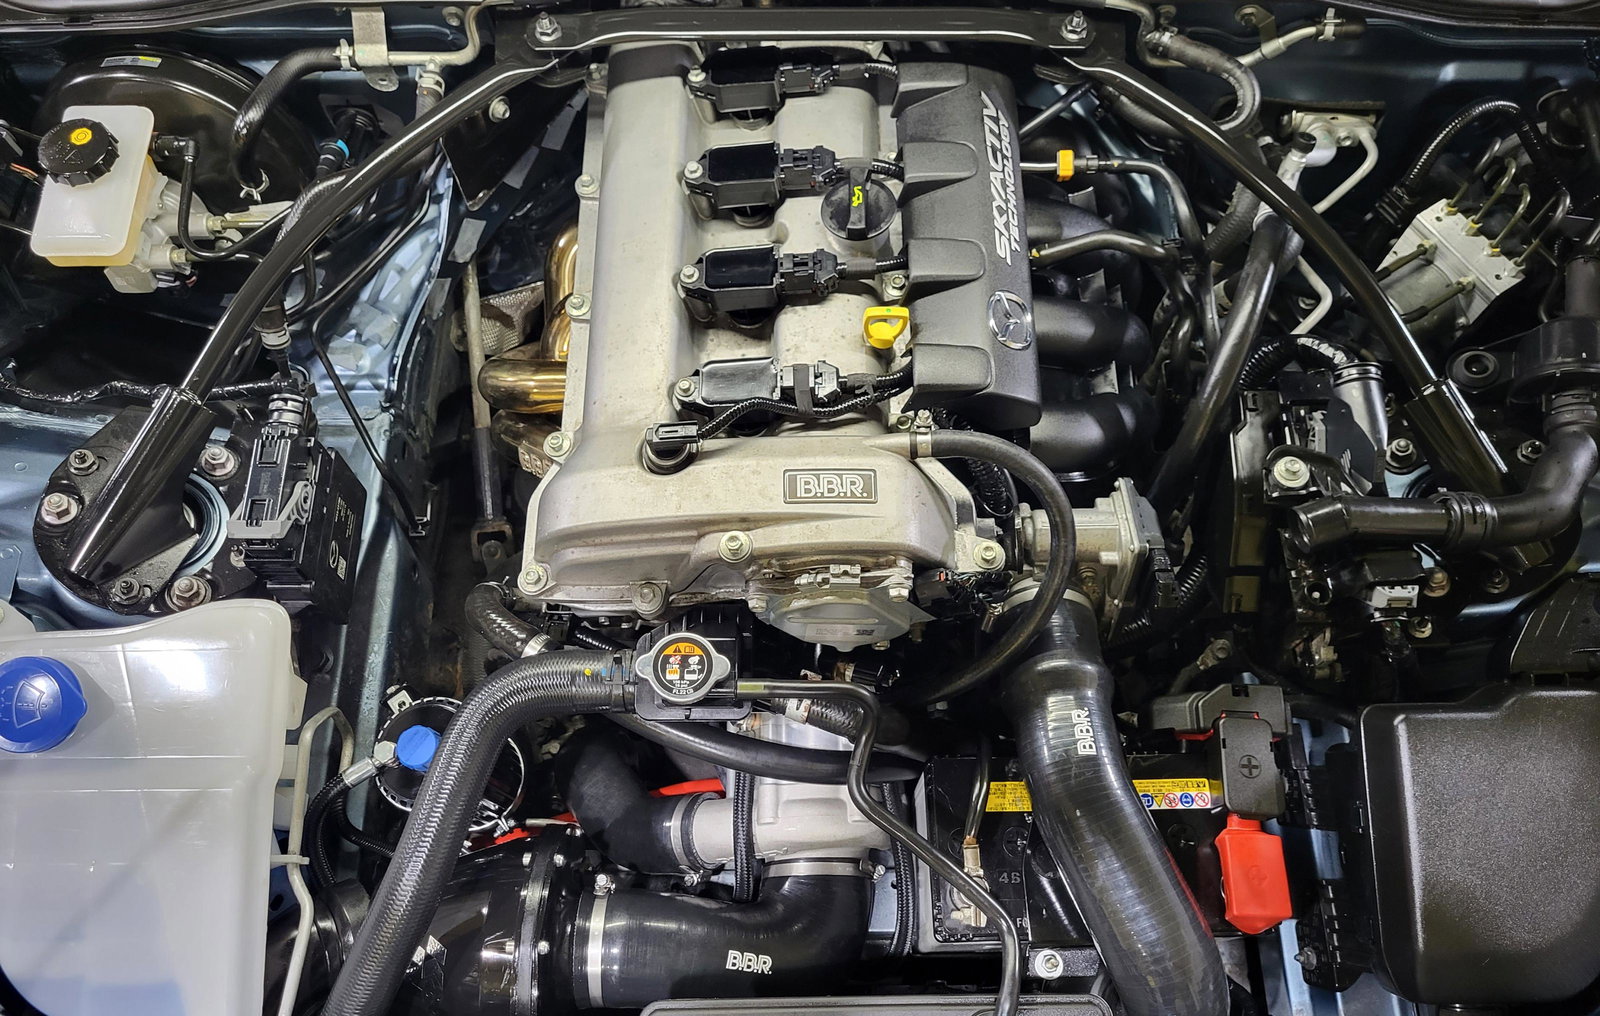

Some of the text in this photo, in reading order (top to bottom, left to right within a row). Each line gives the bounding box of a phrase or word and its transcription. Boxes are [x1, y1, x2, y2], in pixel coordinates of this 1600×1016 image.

[980, 90, 1012, 267] SKYACTIV
[998, 109, 1021, 252] TECHNOLOGY
[796, 474, 868, 497] B.B.R.
[1071, 707, 1097, 755] B.B.R.
[725, 949, 773, 975] B.B.R.
